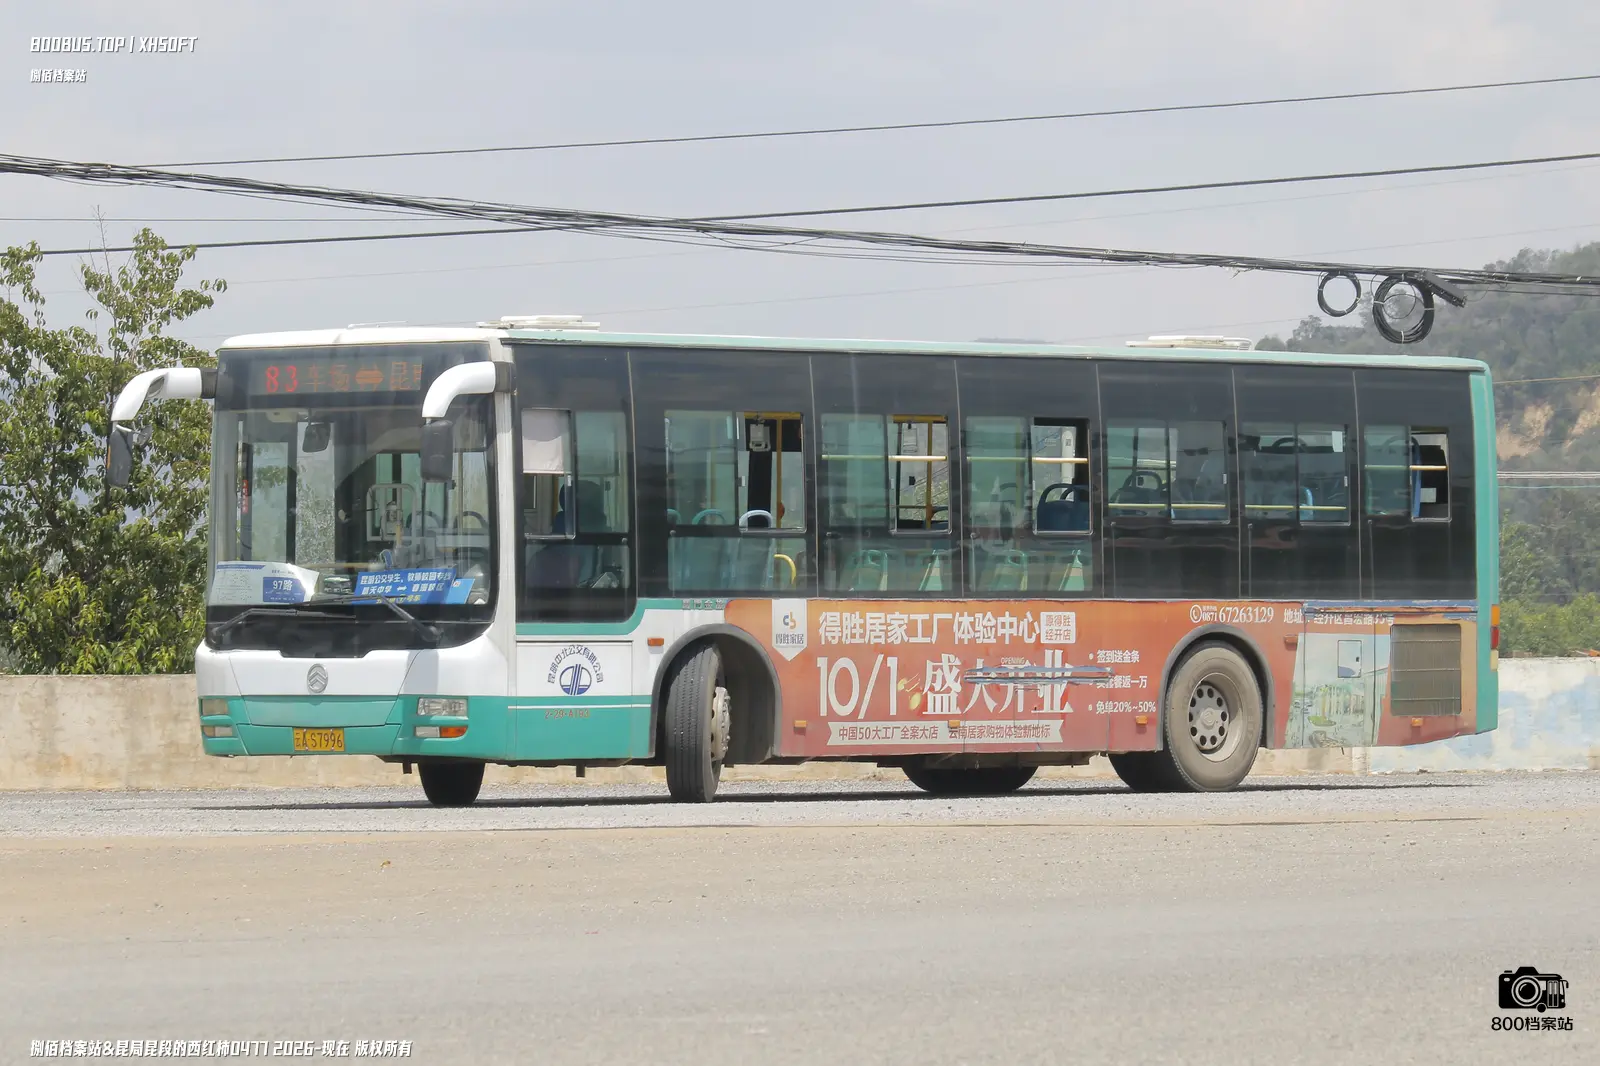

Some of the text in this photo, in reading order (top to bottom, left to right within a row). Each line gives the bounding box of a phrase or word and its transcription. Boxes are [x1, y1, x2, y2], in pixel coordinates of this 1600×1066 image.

[265, 365, 298, 393] 83
[272, 579, 293, 591] 97路
[1202, 612, 1217, 622] 0871
[1219, 606, 1274, 623] 67263129
[819, 611, 1040, 645] 得胜居家工厂体验中心
[1045, 628, 1071, 641] 经开店
[547, 644, 603, 684] 昆明中北公交有限公司
[1097, 650, 1140, 663] 签到送金条
[817, 650, 1074, 719] 10/1 盛大开业
[838, 724, 1051, 741] 中国50大工厂全案大店 云南居家购物体验新地标
